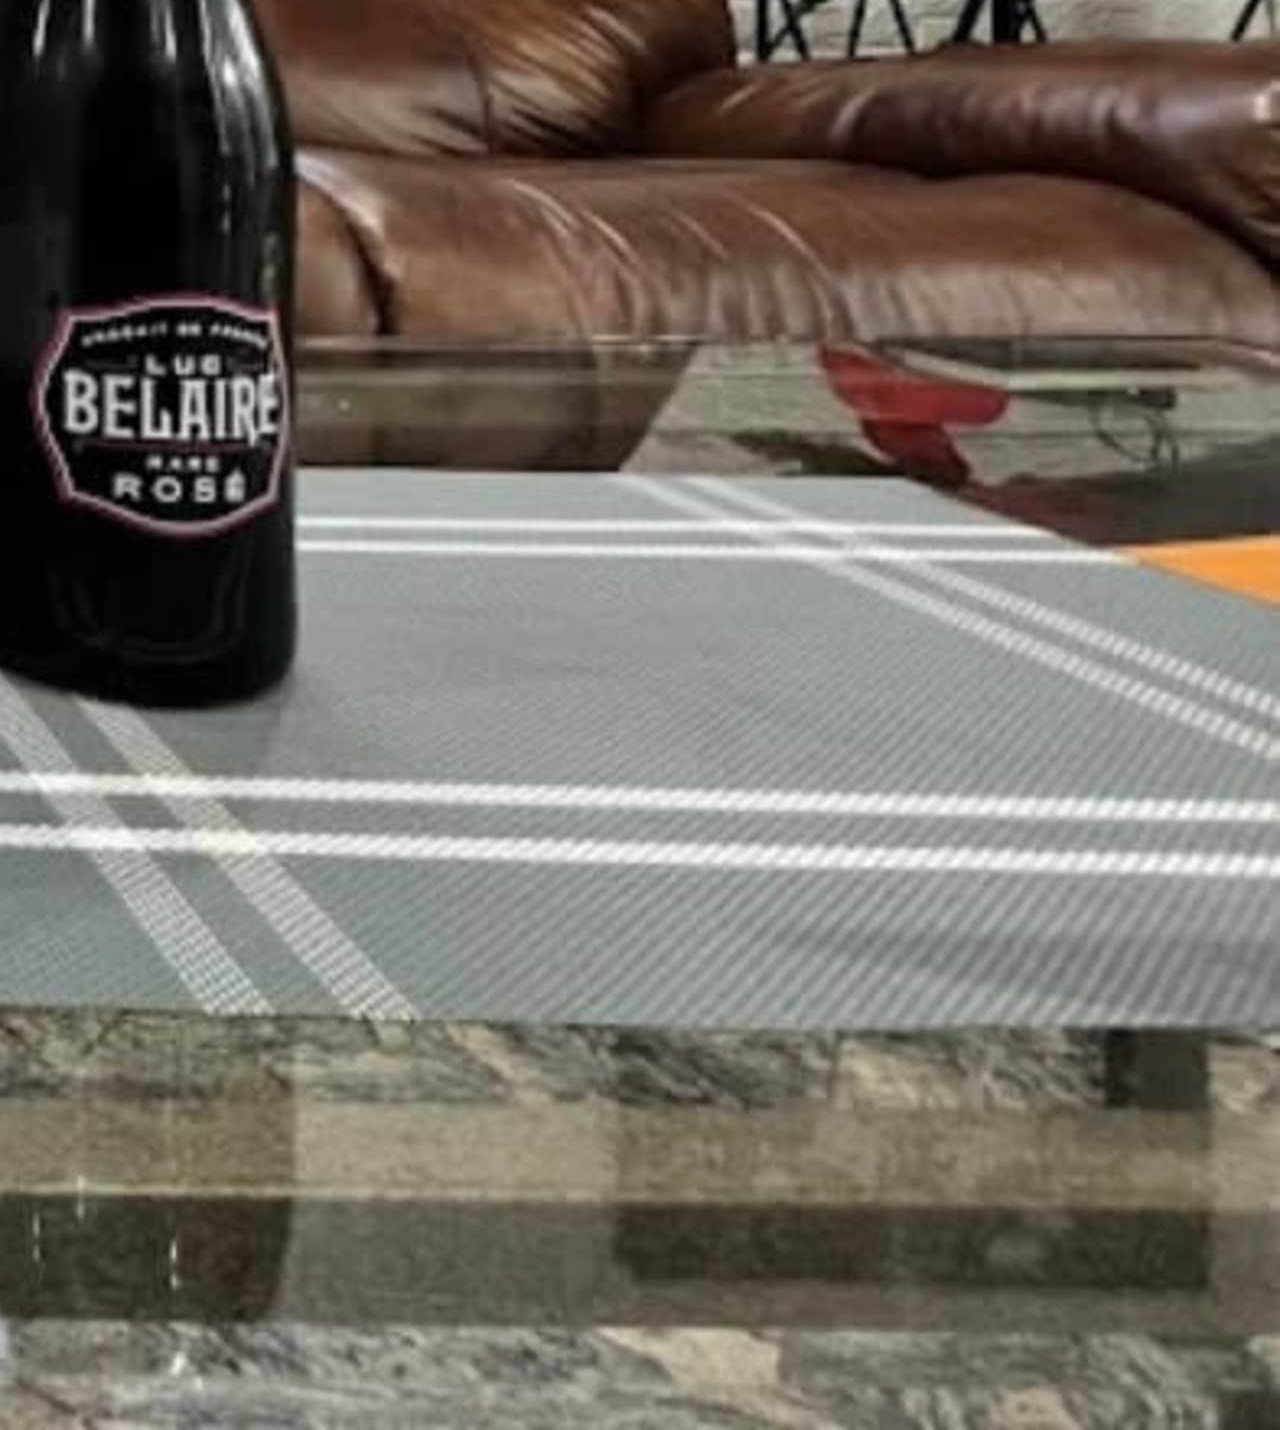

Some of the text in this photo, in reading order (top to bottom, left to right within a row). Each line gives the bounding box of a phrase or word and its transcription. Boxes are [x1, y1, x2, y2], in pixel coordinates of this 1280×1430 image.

[144, 352, 223, 376] LUC
[62, 368, 280, 448] BELAIRE
[111, 467, 247, 504] ROSÉ
